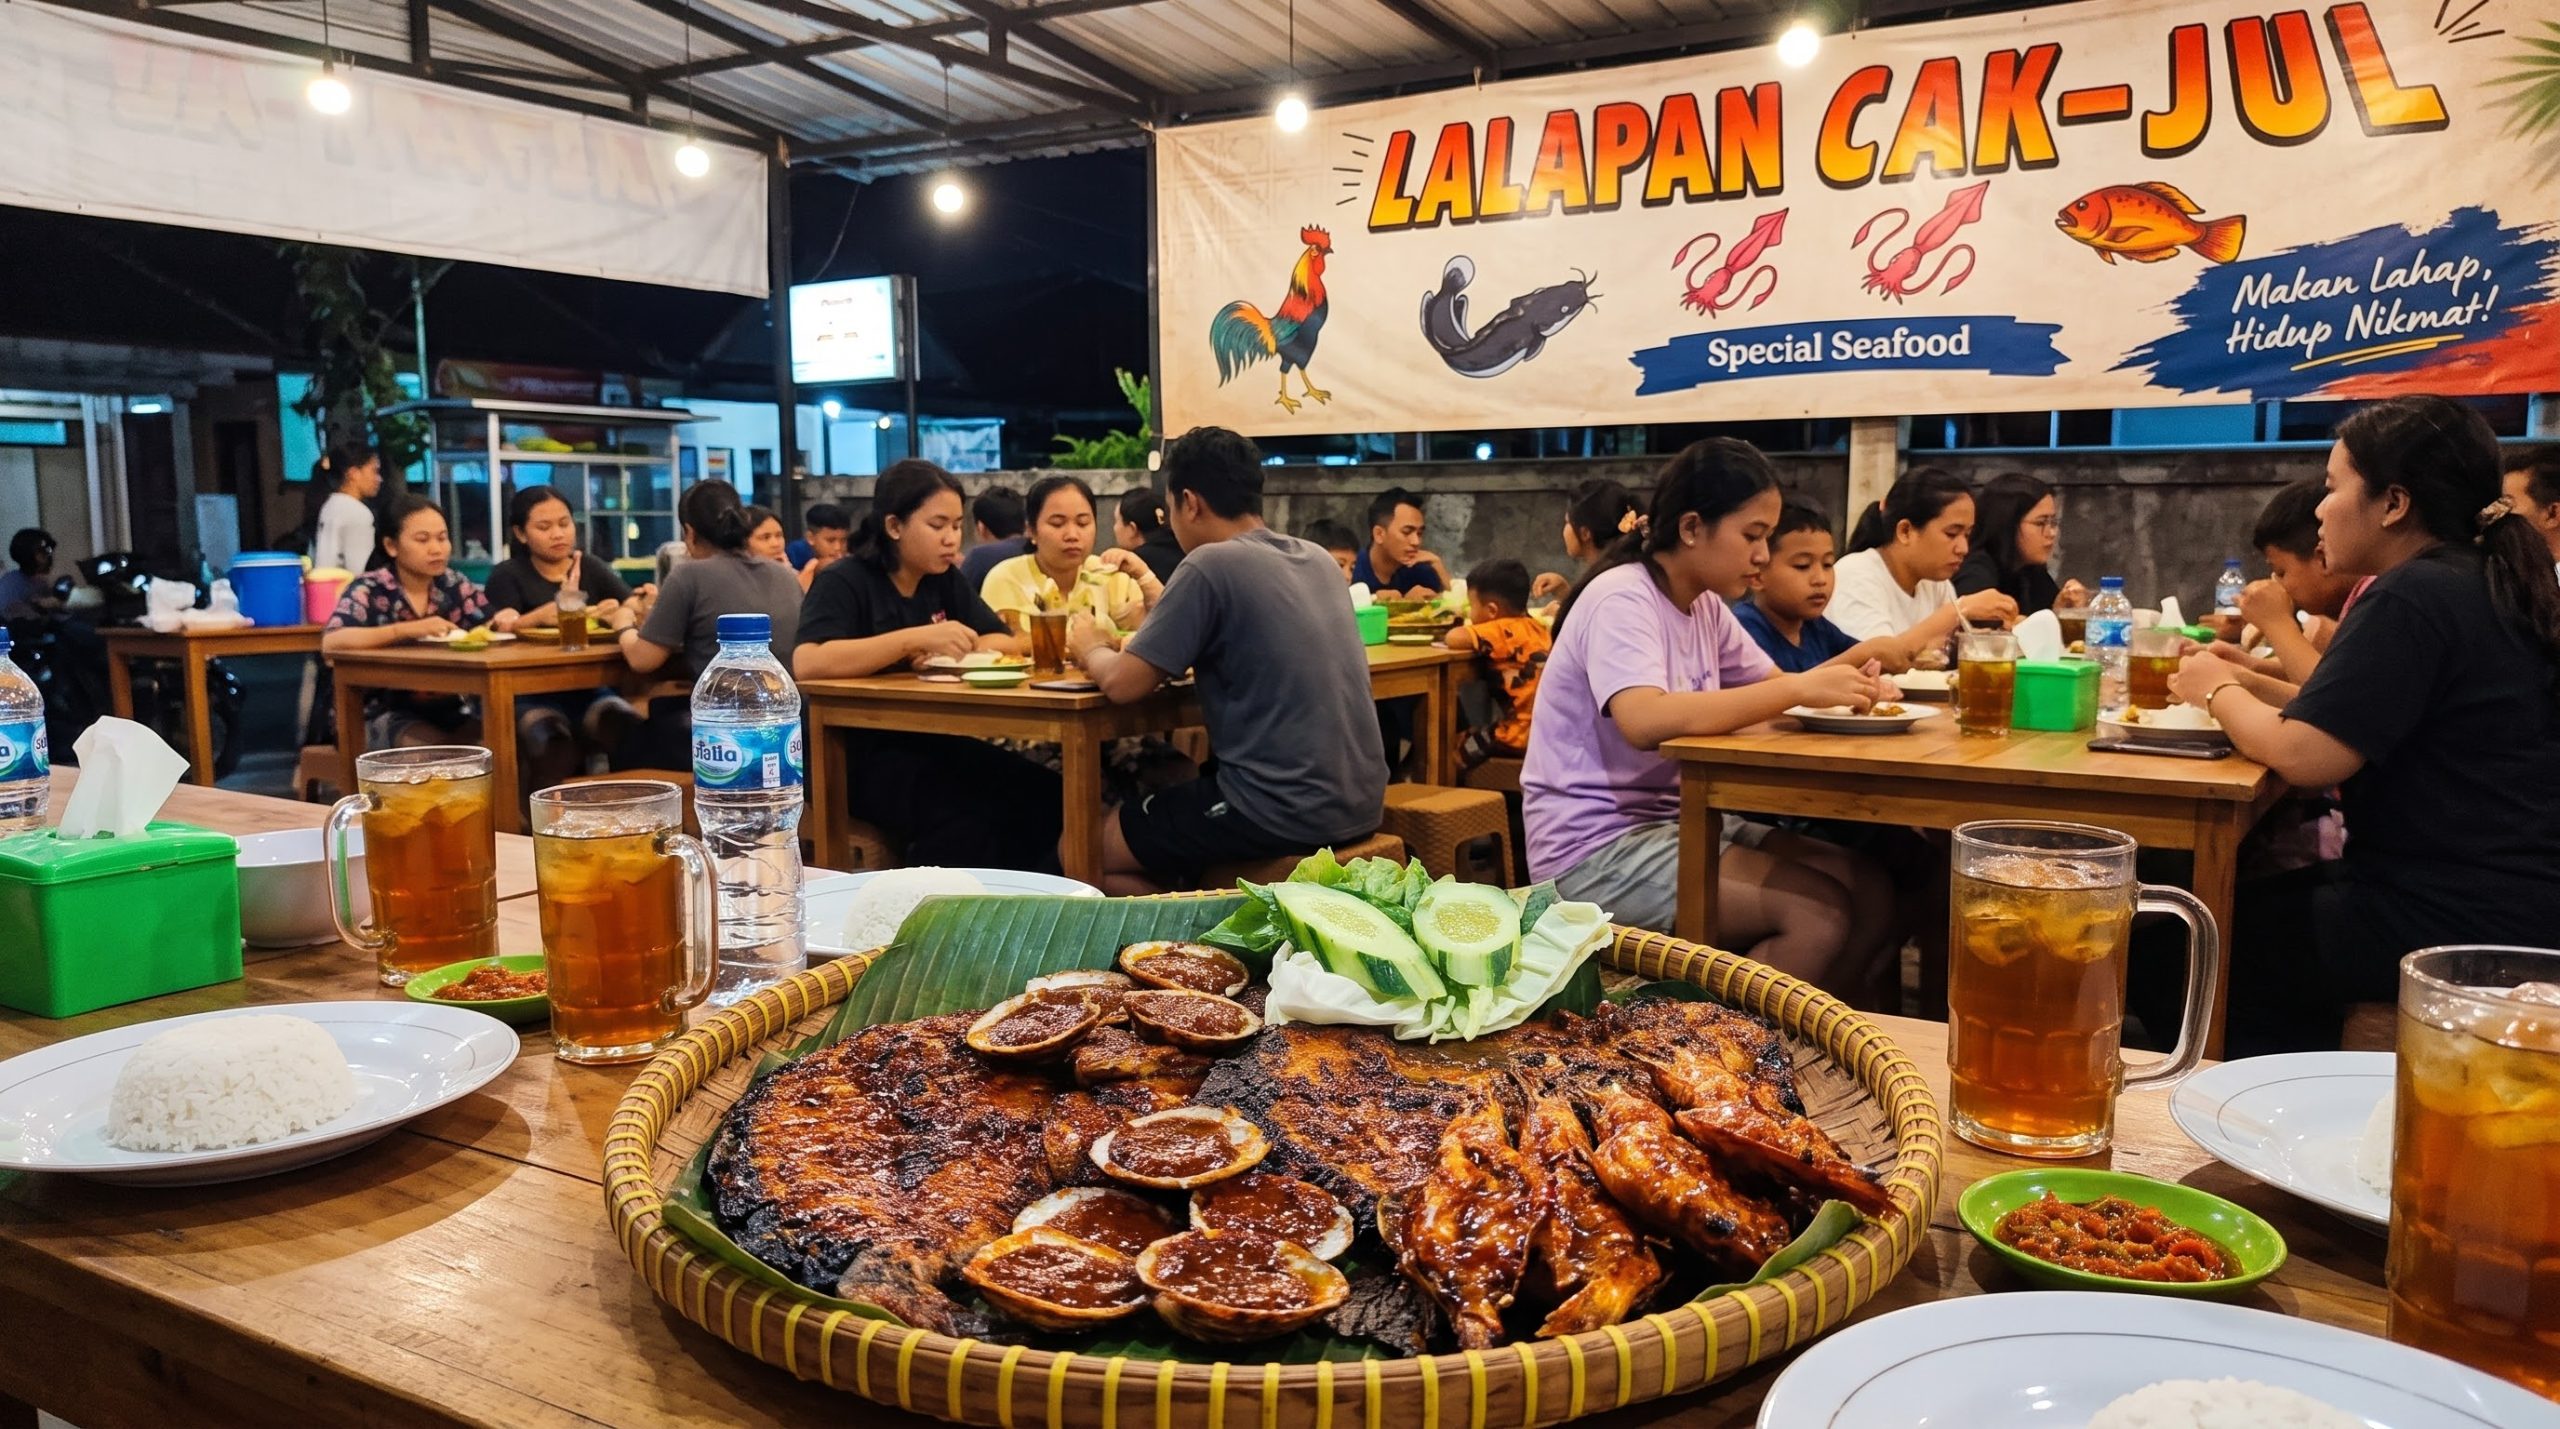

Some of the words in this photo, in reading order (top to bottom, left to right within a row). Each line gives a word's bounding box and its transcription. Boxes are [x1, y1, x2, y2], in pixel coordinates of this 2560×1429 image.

[1368, 81, 1783, 232] LALAPAN
[1815, 1, 2450, 190] CAK-JUL
[2231, 266, 2359, 314] Makan
[2370, 248, 2492, 297] Lahap,
[1708, 331, 1823, 373] Special
[1831, 324, 1971, 361] Seafood
[2226, 314, 2332, 359] Hidup
[2345, 284, 2499, 341] Nikmat!
